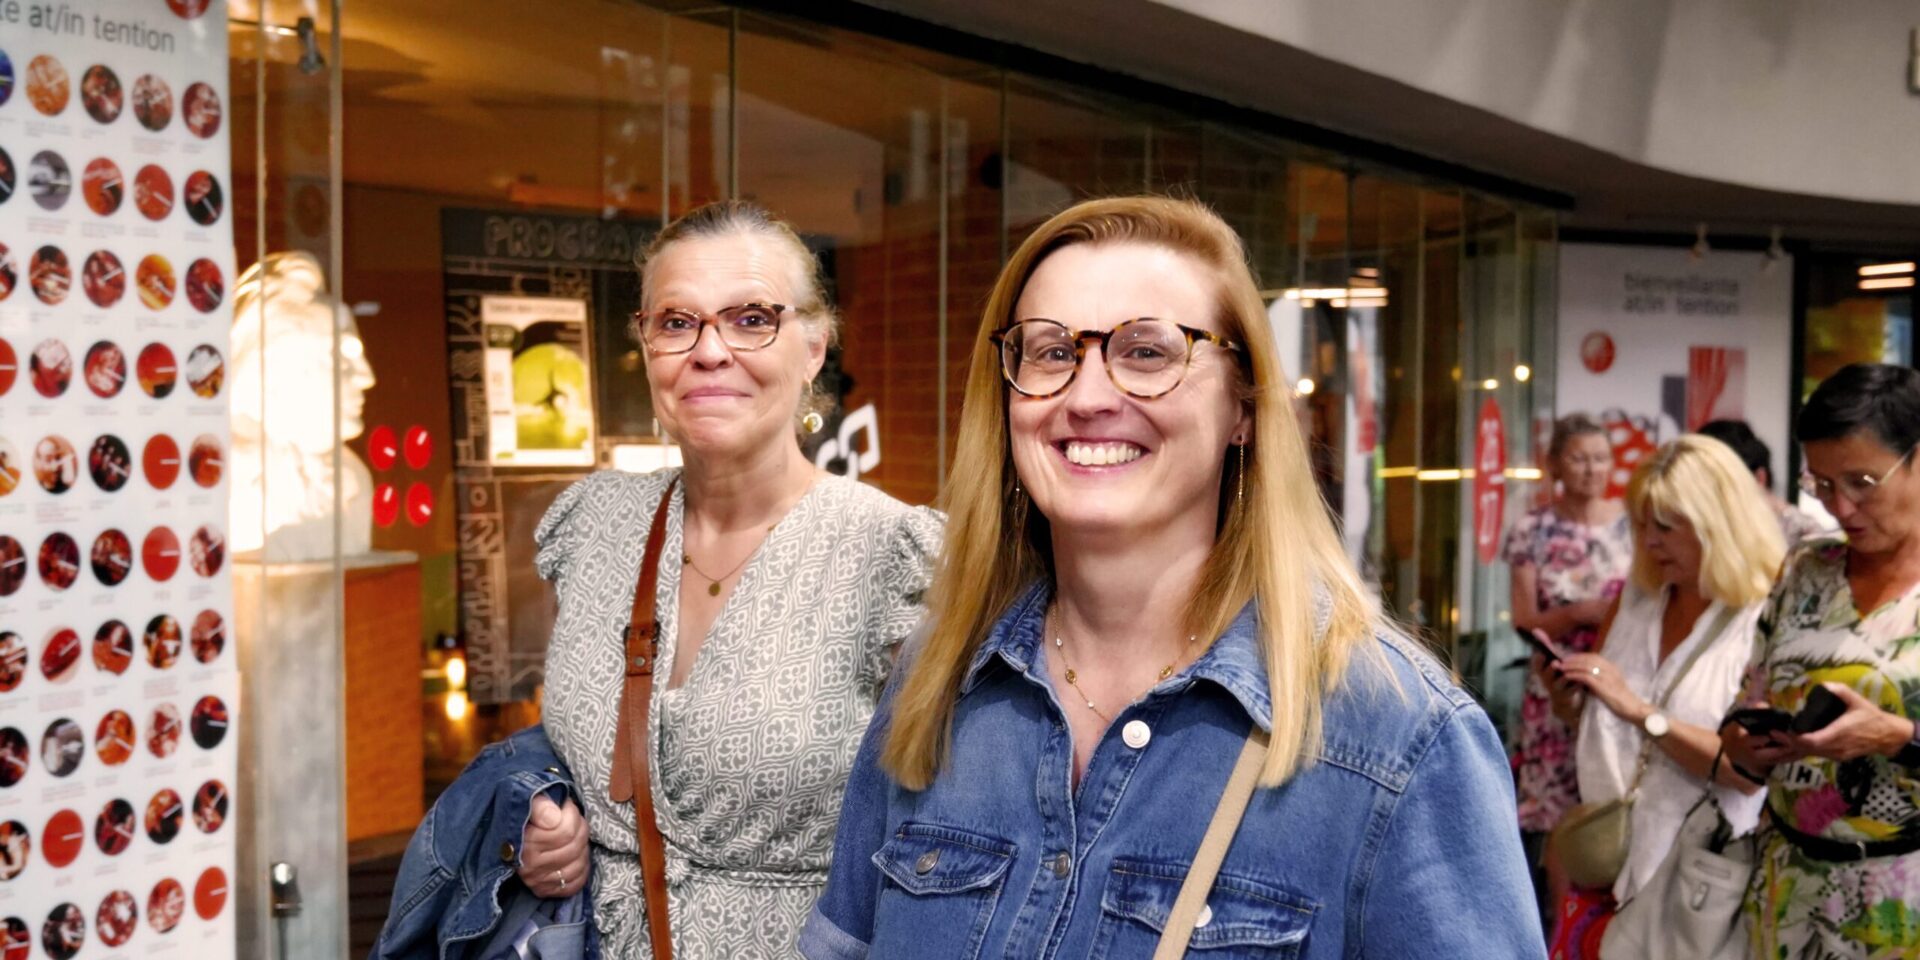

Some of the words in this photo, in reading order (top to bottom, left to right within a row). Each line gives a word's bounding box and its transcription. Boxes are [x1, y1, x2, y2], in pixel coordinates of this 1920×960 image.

[29, 4, 85, 37] at/in
[93, 15, 176, 53] tention
[484, 215, 636, 262] PROGRA
[1677, 297, 1739, 316] tention
